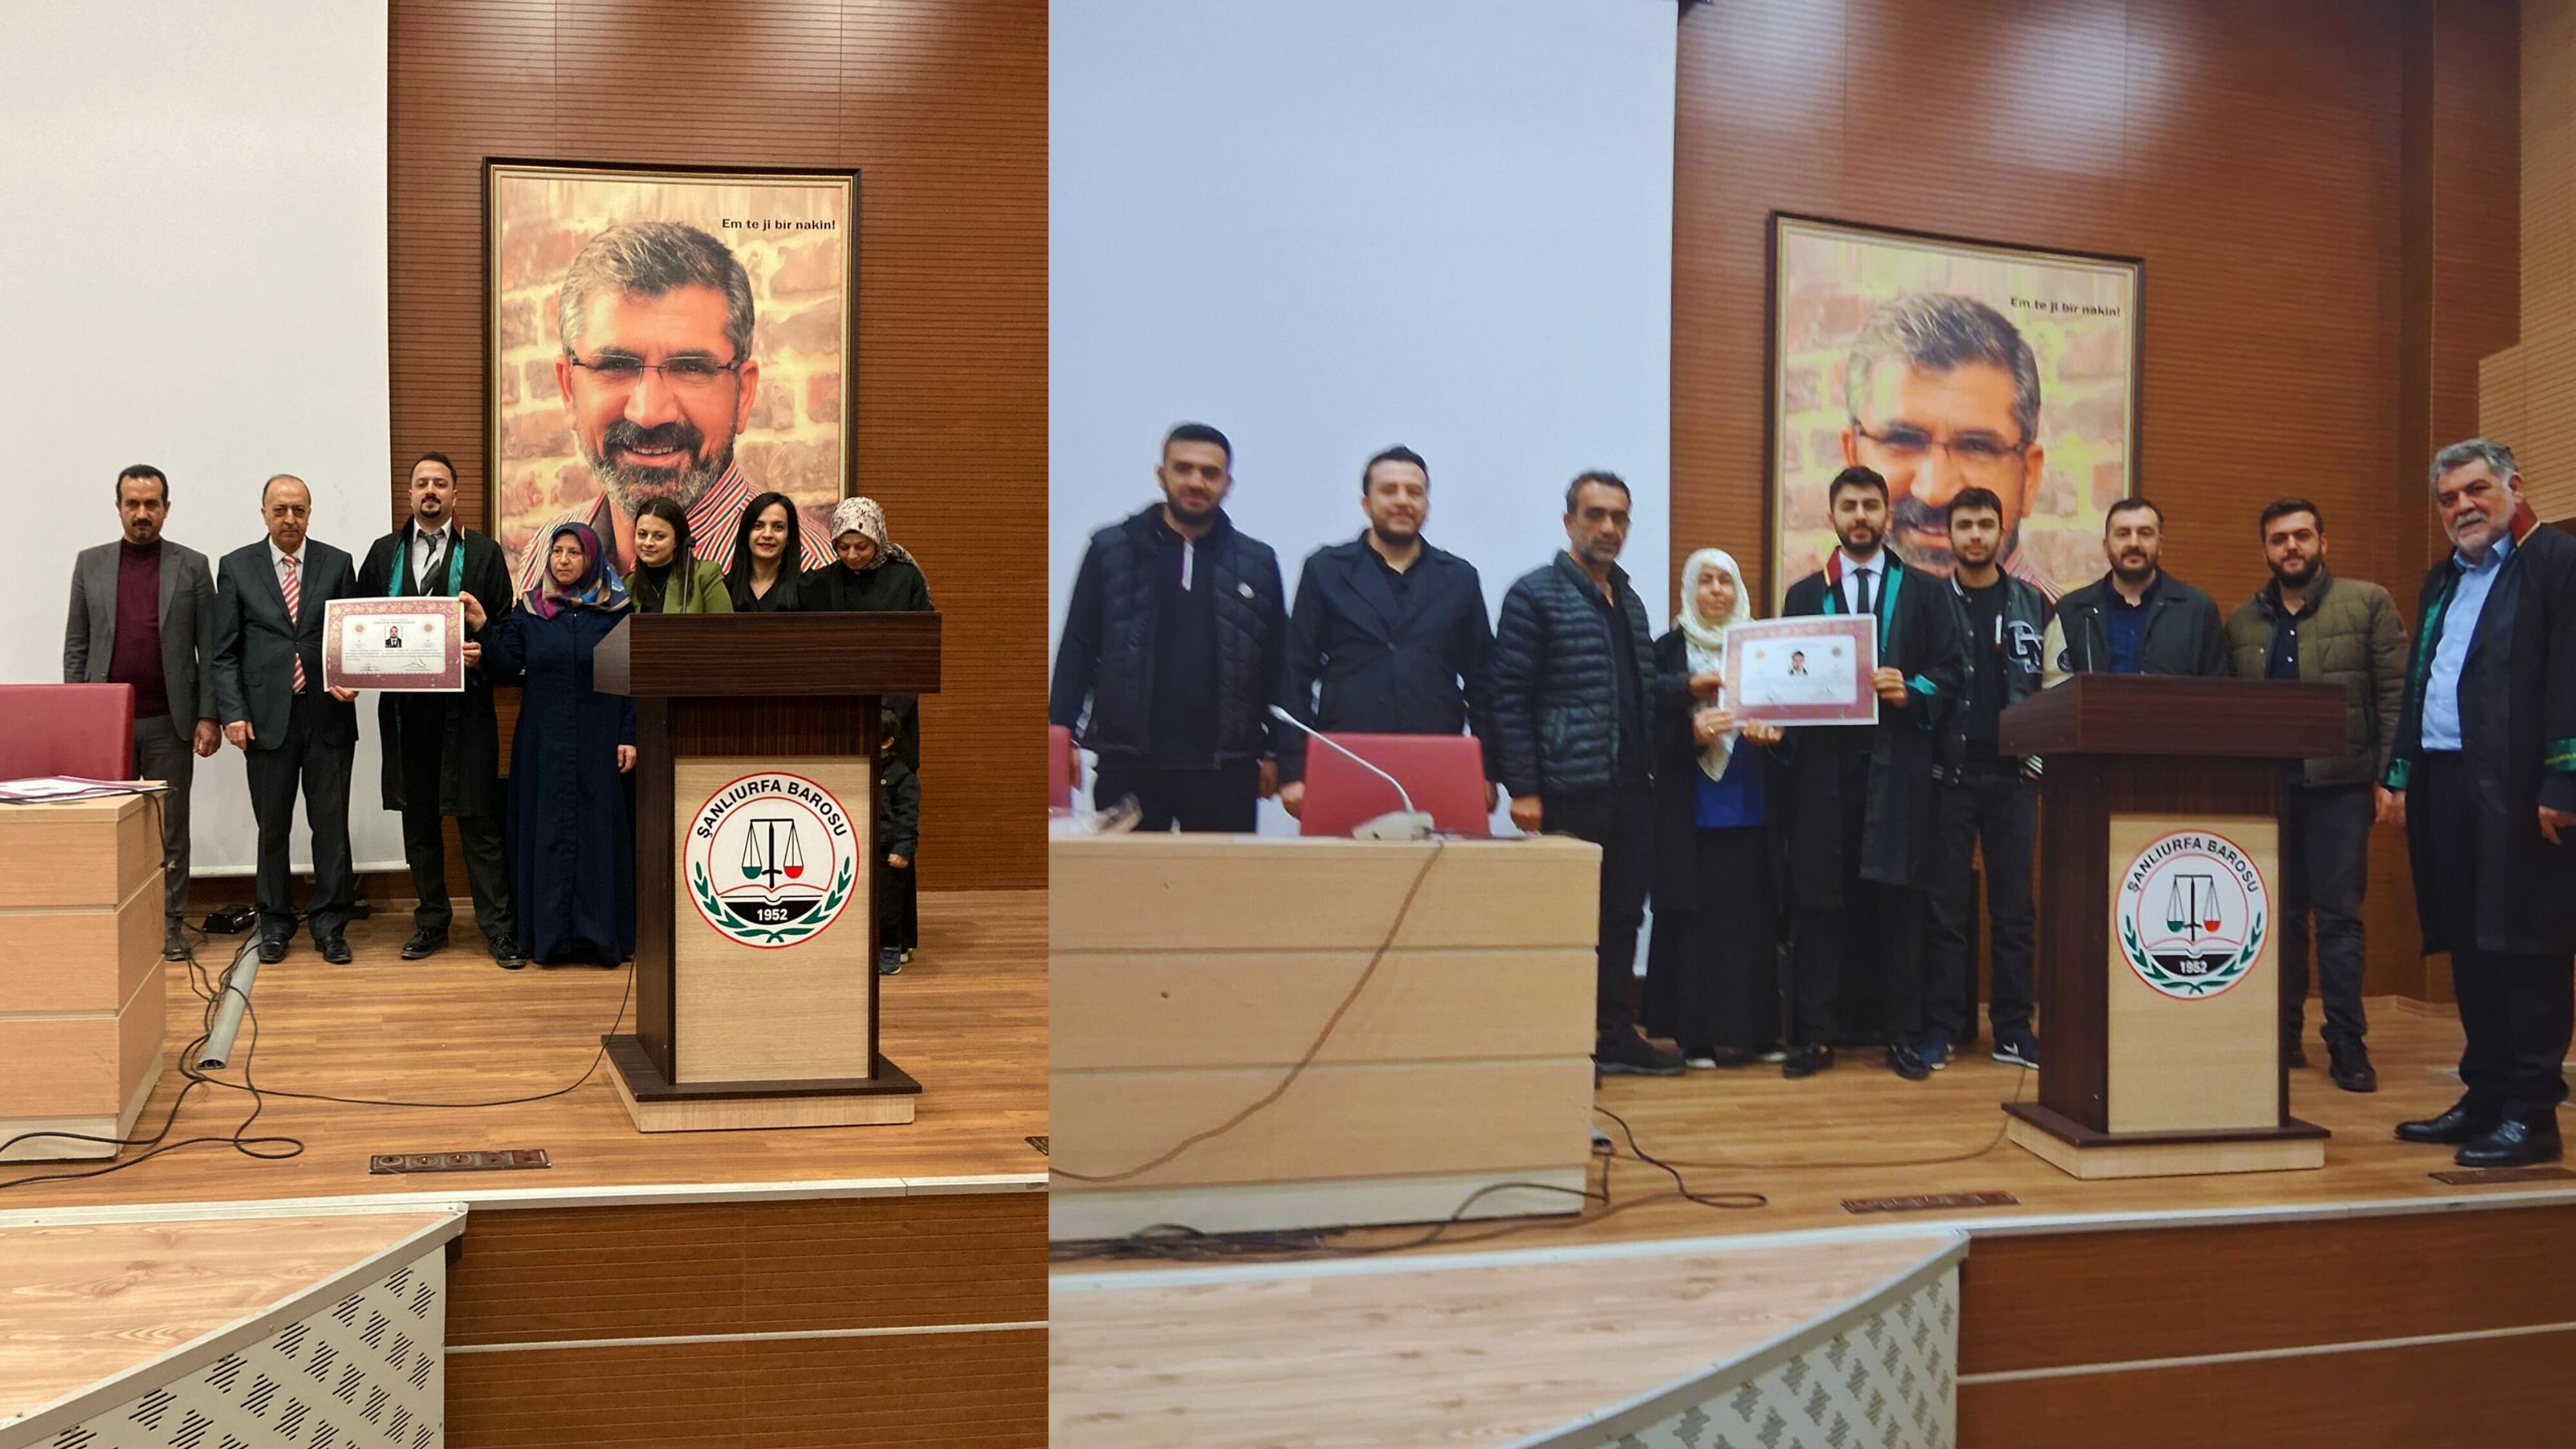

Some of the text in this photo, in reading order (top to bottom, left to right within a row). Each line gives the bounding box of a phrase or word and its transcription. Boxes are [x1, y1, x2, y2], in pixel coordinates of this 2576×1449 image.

[722, 218, 835, 231] Em te ji bir nakin!
[2011, 296, 2031, 309] Em
[2034, 299, 2047, 310] te
[2062, 302, 2078, 314] bir
[2082, 305, 2121, 317] nakin!
[697, 779, 848, 838] ŞANLIURFA BAROSU
[2127, 837, 2259, 893] ŞANLIURFA BAROSU
[757, 909, 788, 921] 1952
[2179, 960, 2208, 974] 1952
